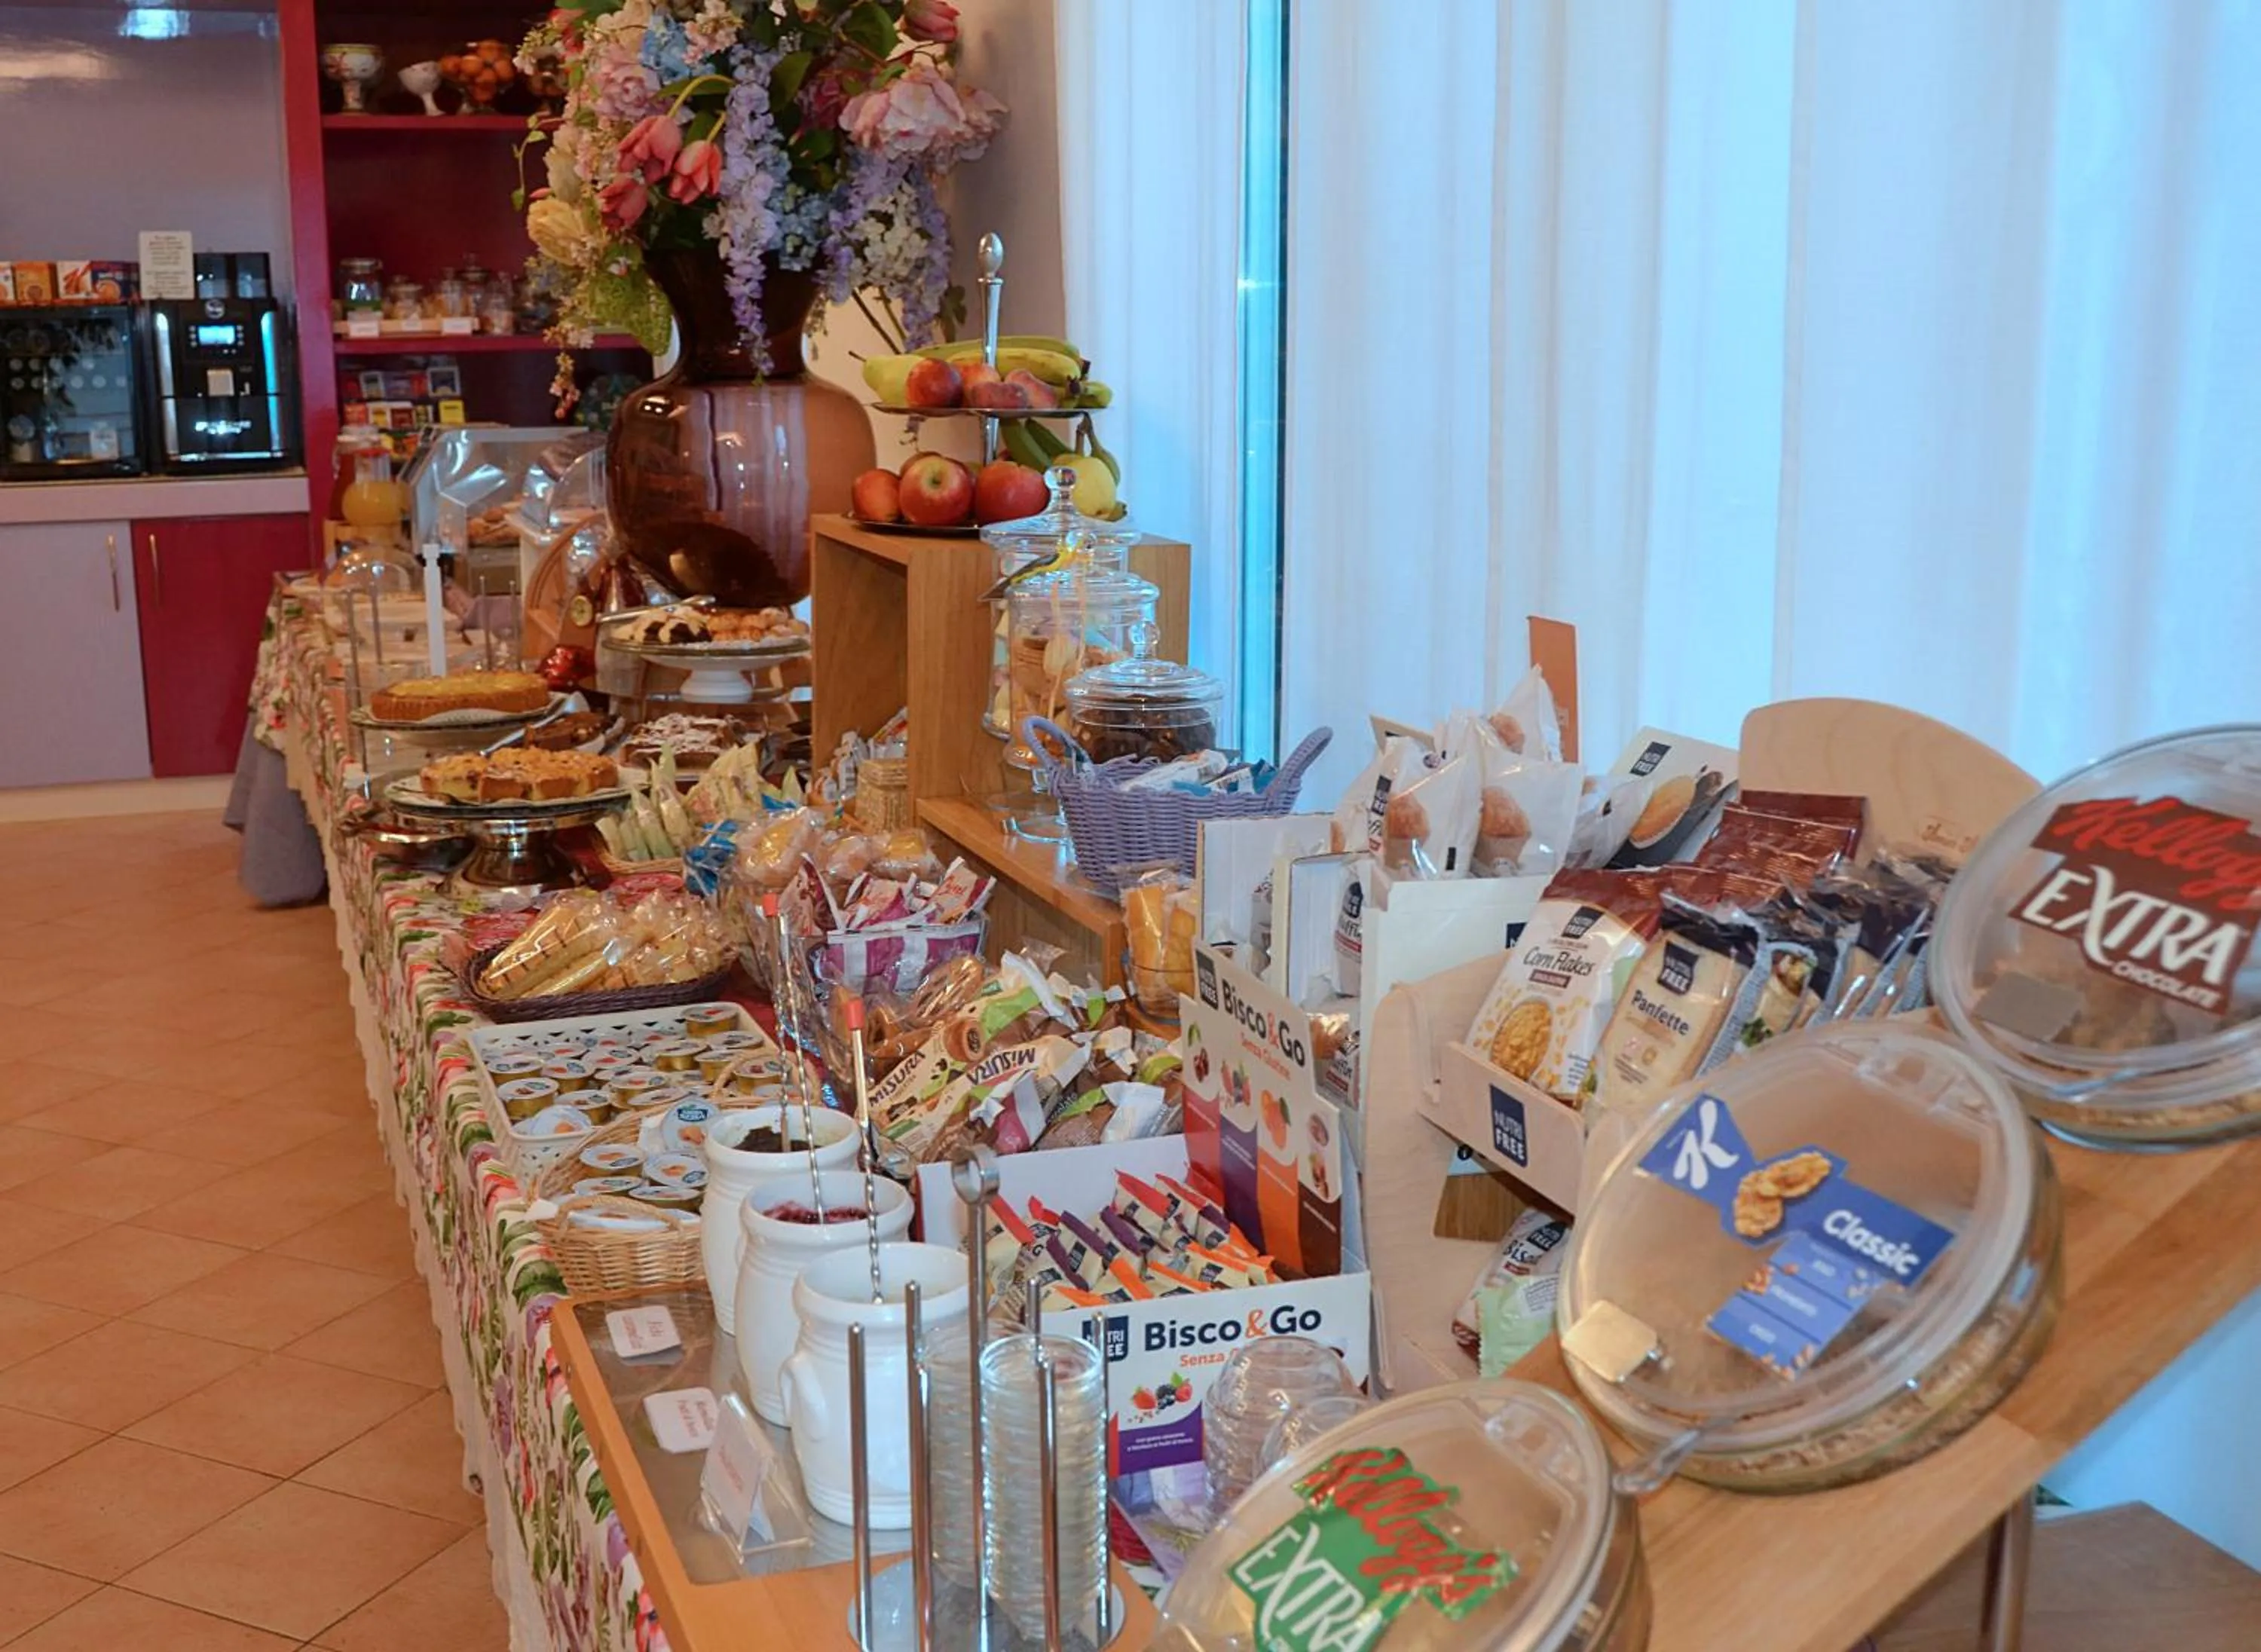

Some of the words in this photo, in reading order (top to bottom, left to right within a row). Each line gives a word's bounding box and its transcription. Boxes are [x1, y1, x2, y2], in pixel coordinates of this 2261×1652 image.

[2021, 864, 2239, 984] EXTRA
[1523, 946, 1555, 969] Corn
[1553, 951, 1596, 976] Flakes
[1661, 967, 1689, 993] FREE
[2113, 960, 2221, 1010] CHOCOLATE
[1631, 989, 1690, 1036] Panfette
[1495, 1109, 1523, 1140] NUTRI
[1495, 1127, 1525, 1161] FREE
[1823, 1209, 1920, 1275] Classic
[1144, 1305, 1323, 1352] Bisco&Go
[1180, 1353, 1225, 1368] Senza
[1235, 1522, 1383, 1652] EXTRA
